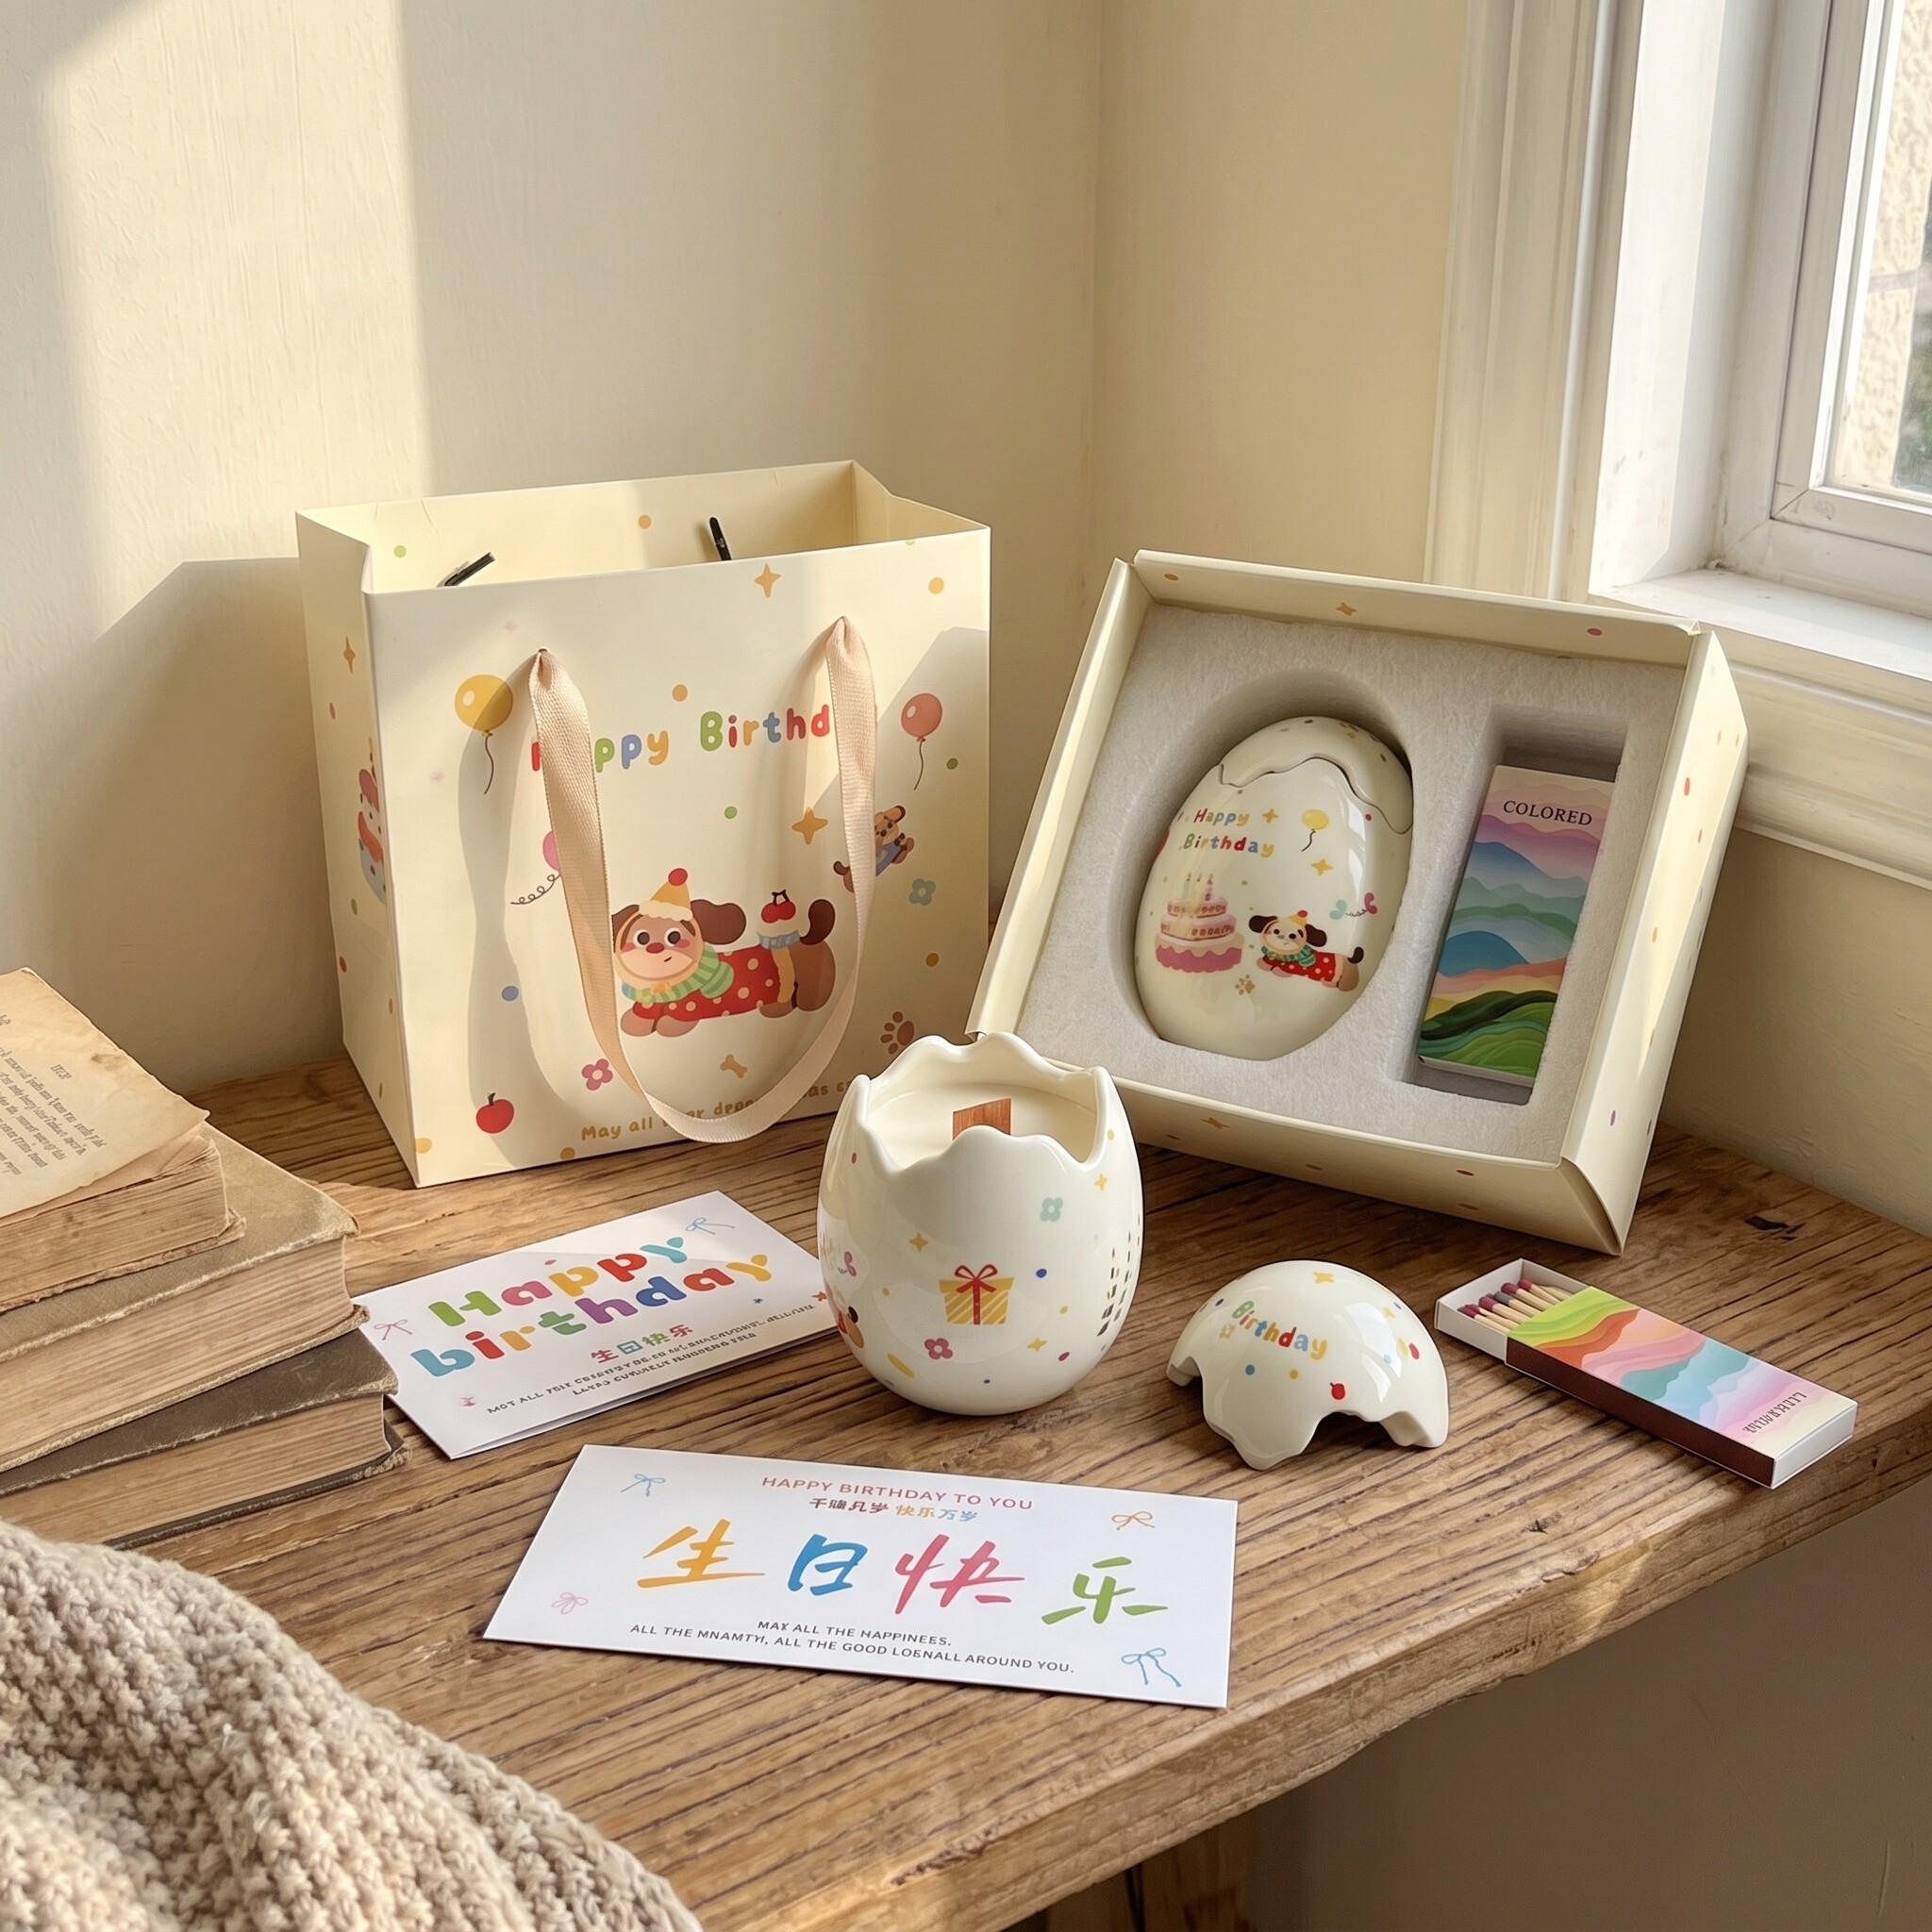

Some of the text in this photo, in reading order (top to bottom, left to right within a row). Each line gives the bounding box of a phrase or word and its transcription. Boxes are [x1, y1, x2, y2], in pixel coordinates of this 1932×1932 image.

[700, 704, 830, 752] Birthd
[1192, 808, 1250, 826] Happy
[1503, 800, 1592, 826] COLORED
[1183, 832, 1274, 858] Birthday
[581, 1125, 622, 1140] May
[629, 1116, 653, 1132] all
[428, 1237, 688, 1326] Happy
[410, 1254, 773, 1377] birthday
[1232, 1300, 1328, 1360] Birthday
[520, 1392, 543, 1404] ALL
[762, 1477, 1033, 1509] HAPPY BIRTHDAY TO YOU
[637, 1519, 1169, 1624] 生日快乐
[792, 1624, 820, 1634] ALL
[826, 1626, 855, 1637] THE
[630, 1624, 658, 1635] ALL
[663, 1626, 693, 1638] THE
[774, 1637, 801, 1647] ALL
[808, 1640, 838, 1651] THE
[842, 1642, 888, 1655] GOOD
[965, 1654, 1033, 1669] AROUND
[1038, 1660, 1074, 1673] YOU.
